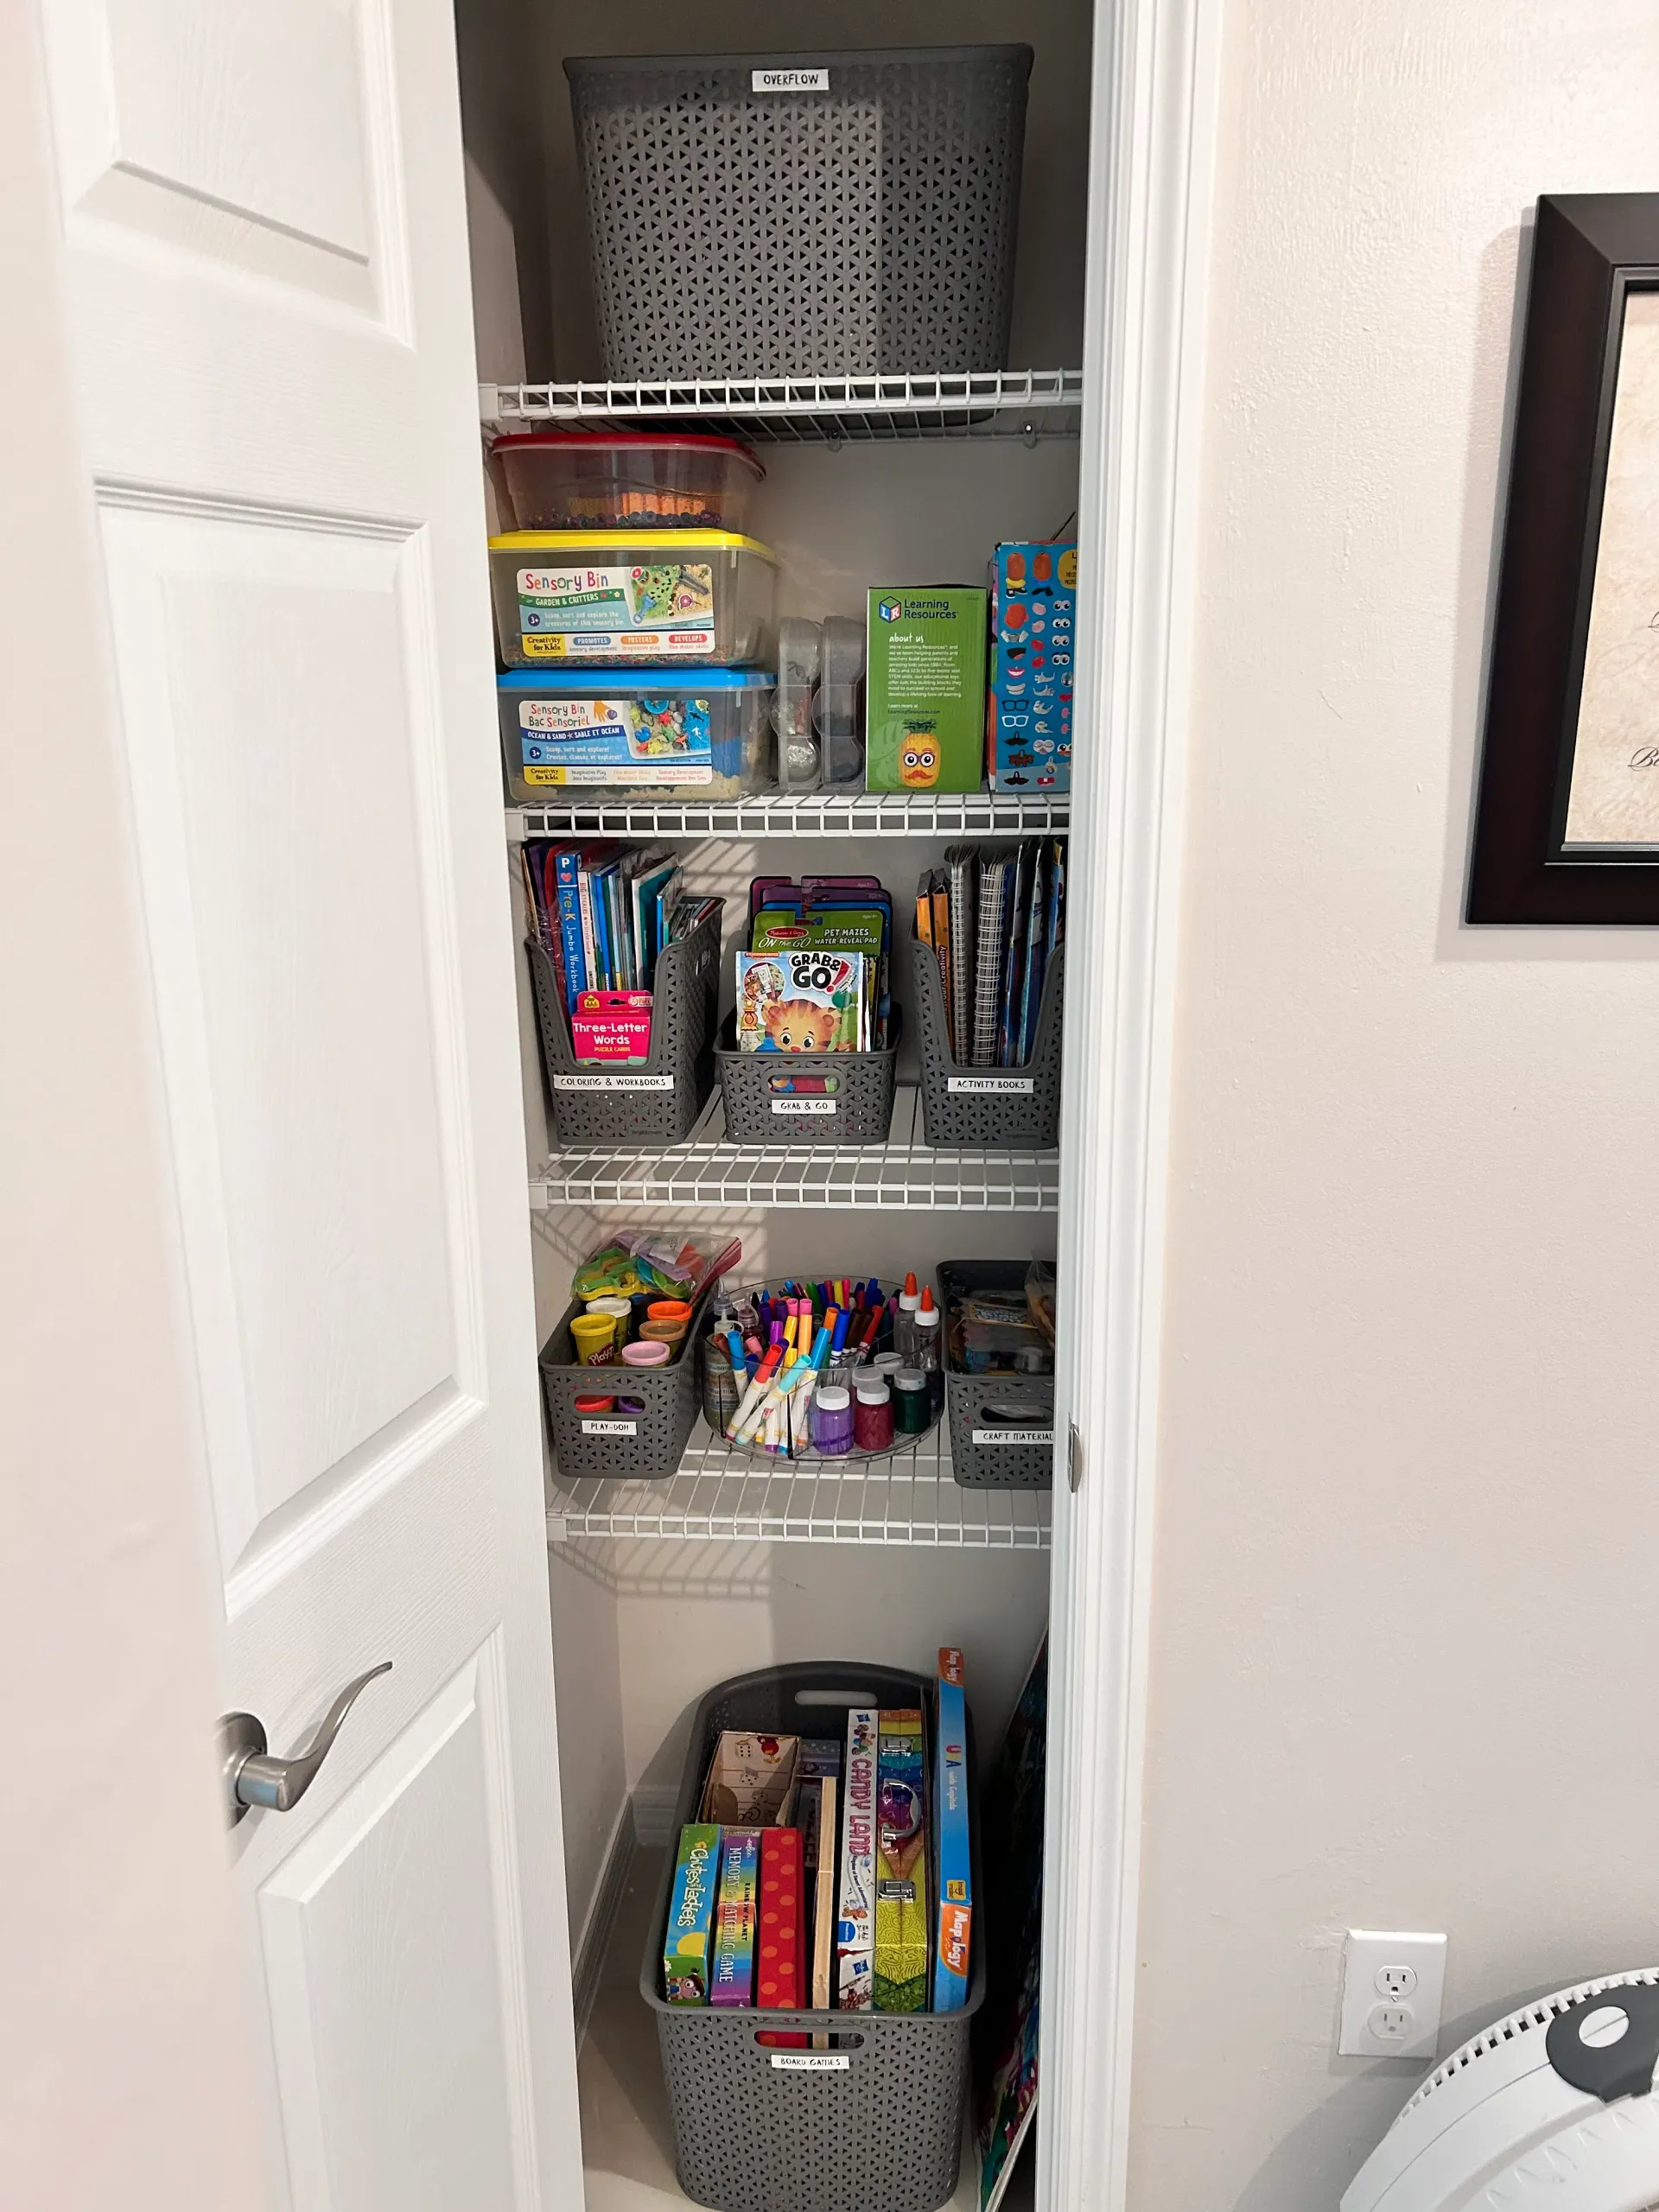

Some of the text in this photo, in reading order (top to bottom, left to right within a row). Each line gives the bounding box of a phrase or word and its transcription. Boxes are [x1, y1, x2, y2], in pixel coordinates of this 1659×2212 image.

[764, 73, 819, 86] OVERFLOW
[525, 571, 608, 592] Sensory Bin
[569, 593, 599, 604] CRITTERS
[904, 600, 949, 610] Learning
[904, 610, 957, 619] Resources
[889, 632, 924, 643] about us
[531, 703, 585, 716] Sensory Bin
[529, 715, 590, 727] Bac Sensoriel
[562, 857, 570, 868] P
[563, 890, 580, 992] Pre-K Jumbo Workbook
[759, 938, 777, 948] ON
[792, 938, 811, 948] GO
[573, 1023, 648, 1033] Three-Letter
[593, 1035, 630, 1045] Words
[605, 1077, 612, 1086] &
[957, 1080, 995, 1089] ACTIVITY
[849, 1758, 872, 1856] CANDY LAND
[727, 1847, 741, 1887] MEMORY
[677, 1849, 709, 1927] Chutes Ladders
[722, 1901, 738, 1949] MATCHING
[719, 1953, 734, 1983] GAME
[780, 2057, 806, 2066] BOARD
